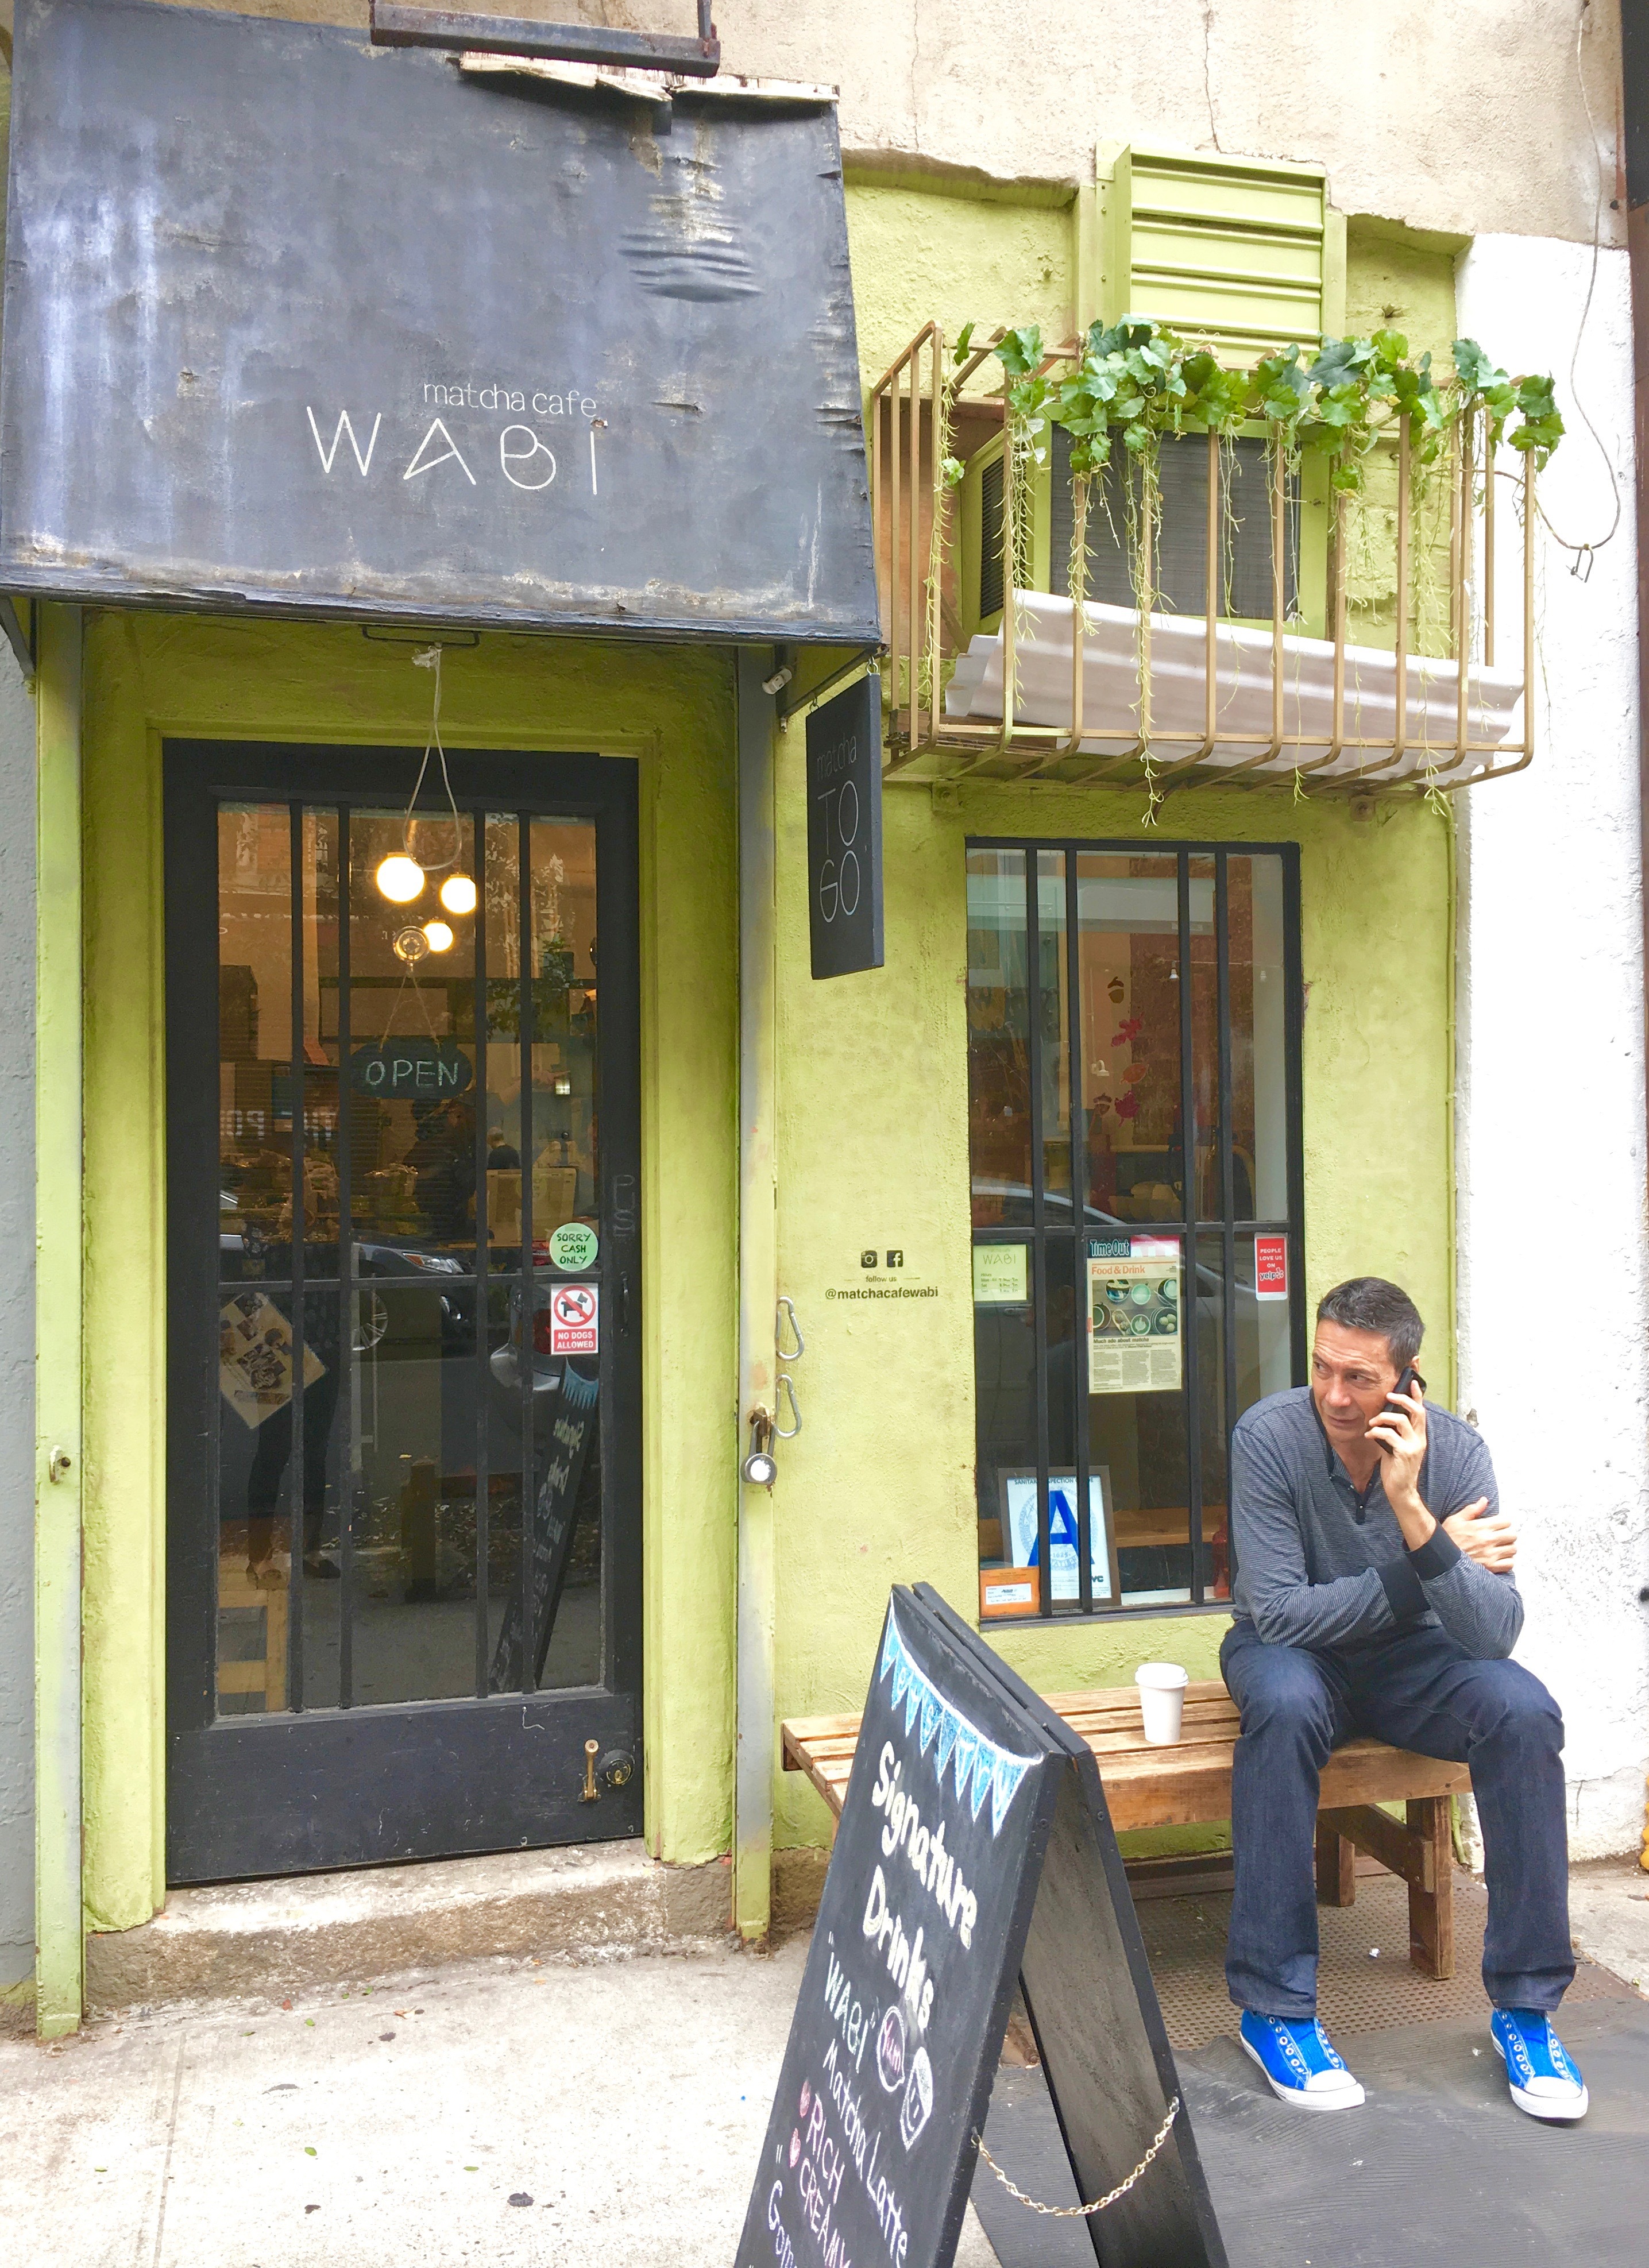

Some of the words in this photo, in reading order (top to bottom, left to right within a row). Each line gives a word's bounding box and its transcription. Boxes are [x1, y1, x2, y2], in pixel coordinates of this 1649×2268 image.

[423, 382, 525, 412] matcha
[532, 389, 597, 418] cafe
[306, 405, 598, 495] WABI
[817, 733, 857, 781] matcha
[817, 779, 859, 855] TO
[820, 849, 860, 923] GO
[365, 1058, 459, 1087] OPEN
[556, 1233, 592, 1242] SORRY
[561, 1244, 586, 1253] CASH
[1090, 1239, 1112, 1257] Time
[1112, 1239, 1130, 1256] Out
[559, 1255, 588, 1264] ONLY
[983, 1253, 1016, 1265] WABI
[1091, 1267, 1113, 1275] Food
[1114, 1266, 1121, 1274] &
[1123, 1265, 1145, 1274] Drink
[1260, 1270, 1276, 1281] yelp
[825, 1286, 939, 1300] @matchacafewabi
[557, 1340, 594, 1349] ALLOWED
[558, 1332, 569, 1340] NO
[571, 1331, 593, 1339] DOGS
[1027, 1490, 1096, 1567] A
[871, 1740, 978, 1950] Signature
[863, 1864, 934, 2030] Drinks
[882, 2019, 901, 2076] Yum
[806, 2092, 845, 2207] RICH
[823, 2038, 867, 2181] Matcha
[866, 2131, 908, 2268] Latte
